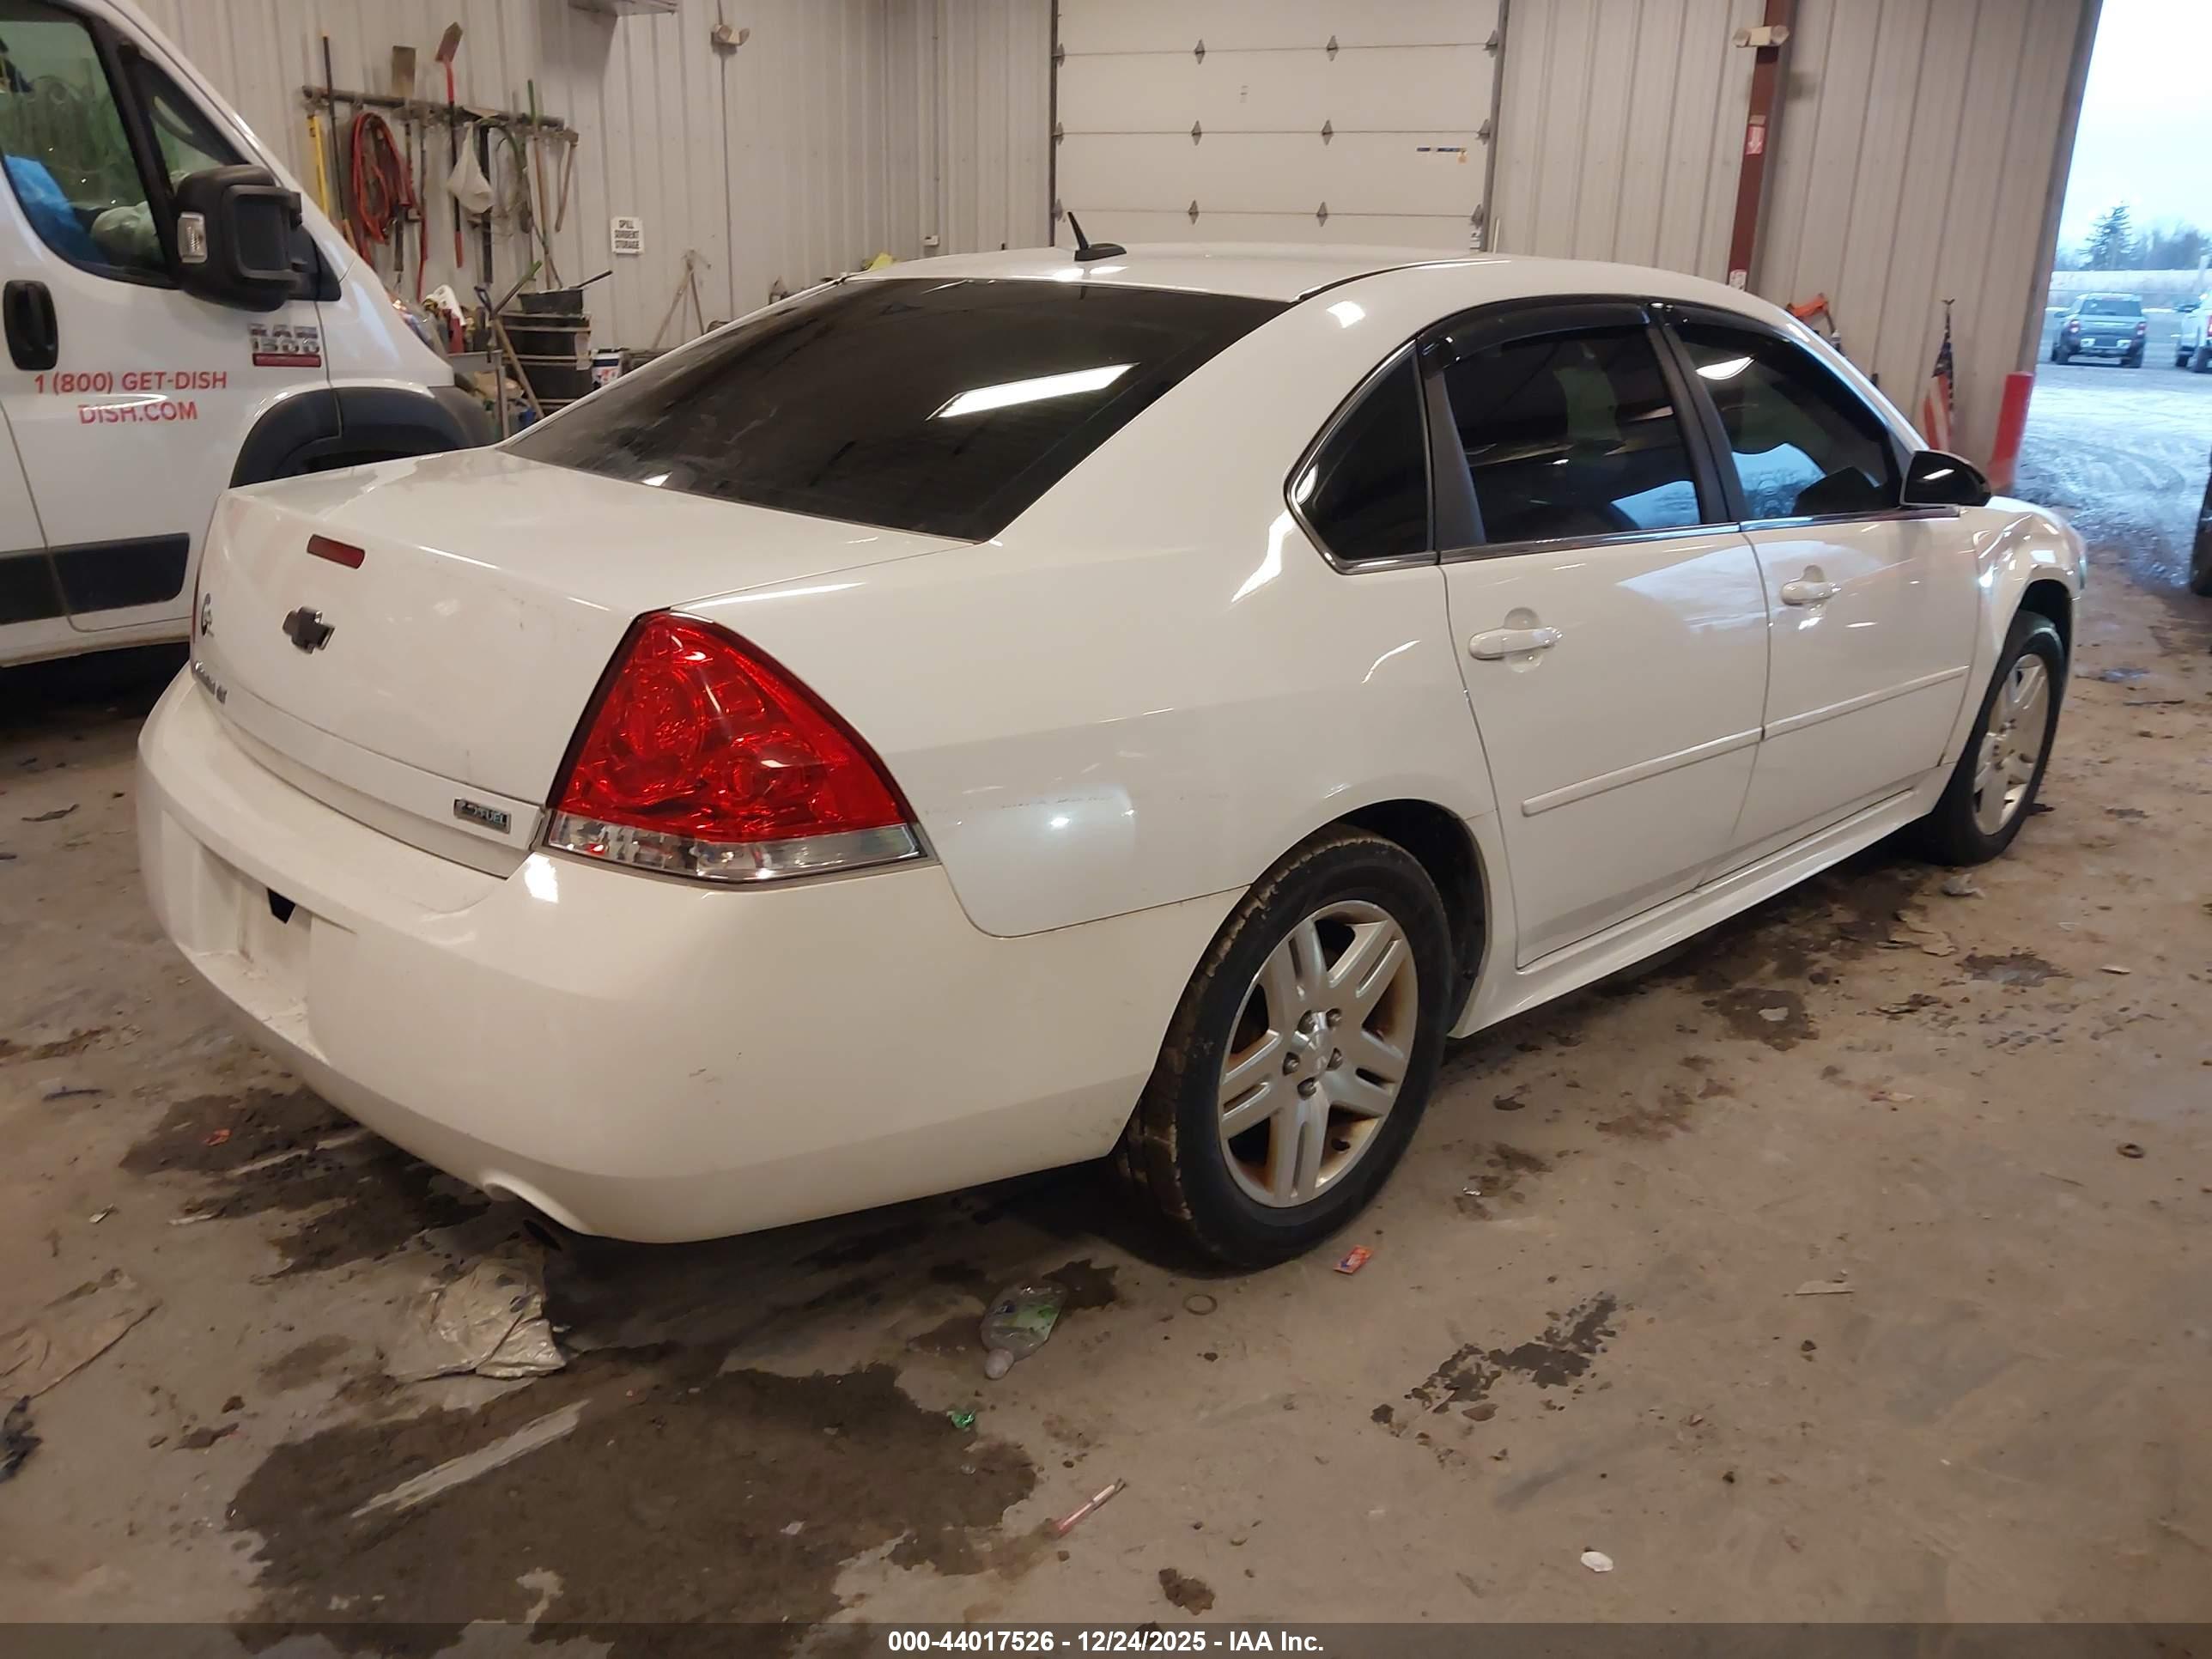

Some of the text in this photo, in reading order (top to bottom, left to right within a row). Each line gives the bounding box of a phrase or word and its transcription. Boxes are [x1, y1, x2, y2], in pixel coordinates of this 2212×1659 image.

[34, 370, 228, 393] 1 (800) GET-DISH
[78, 401, 198, 424] DISH.COM
